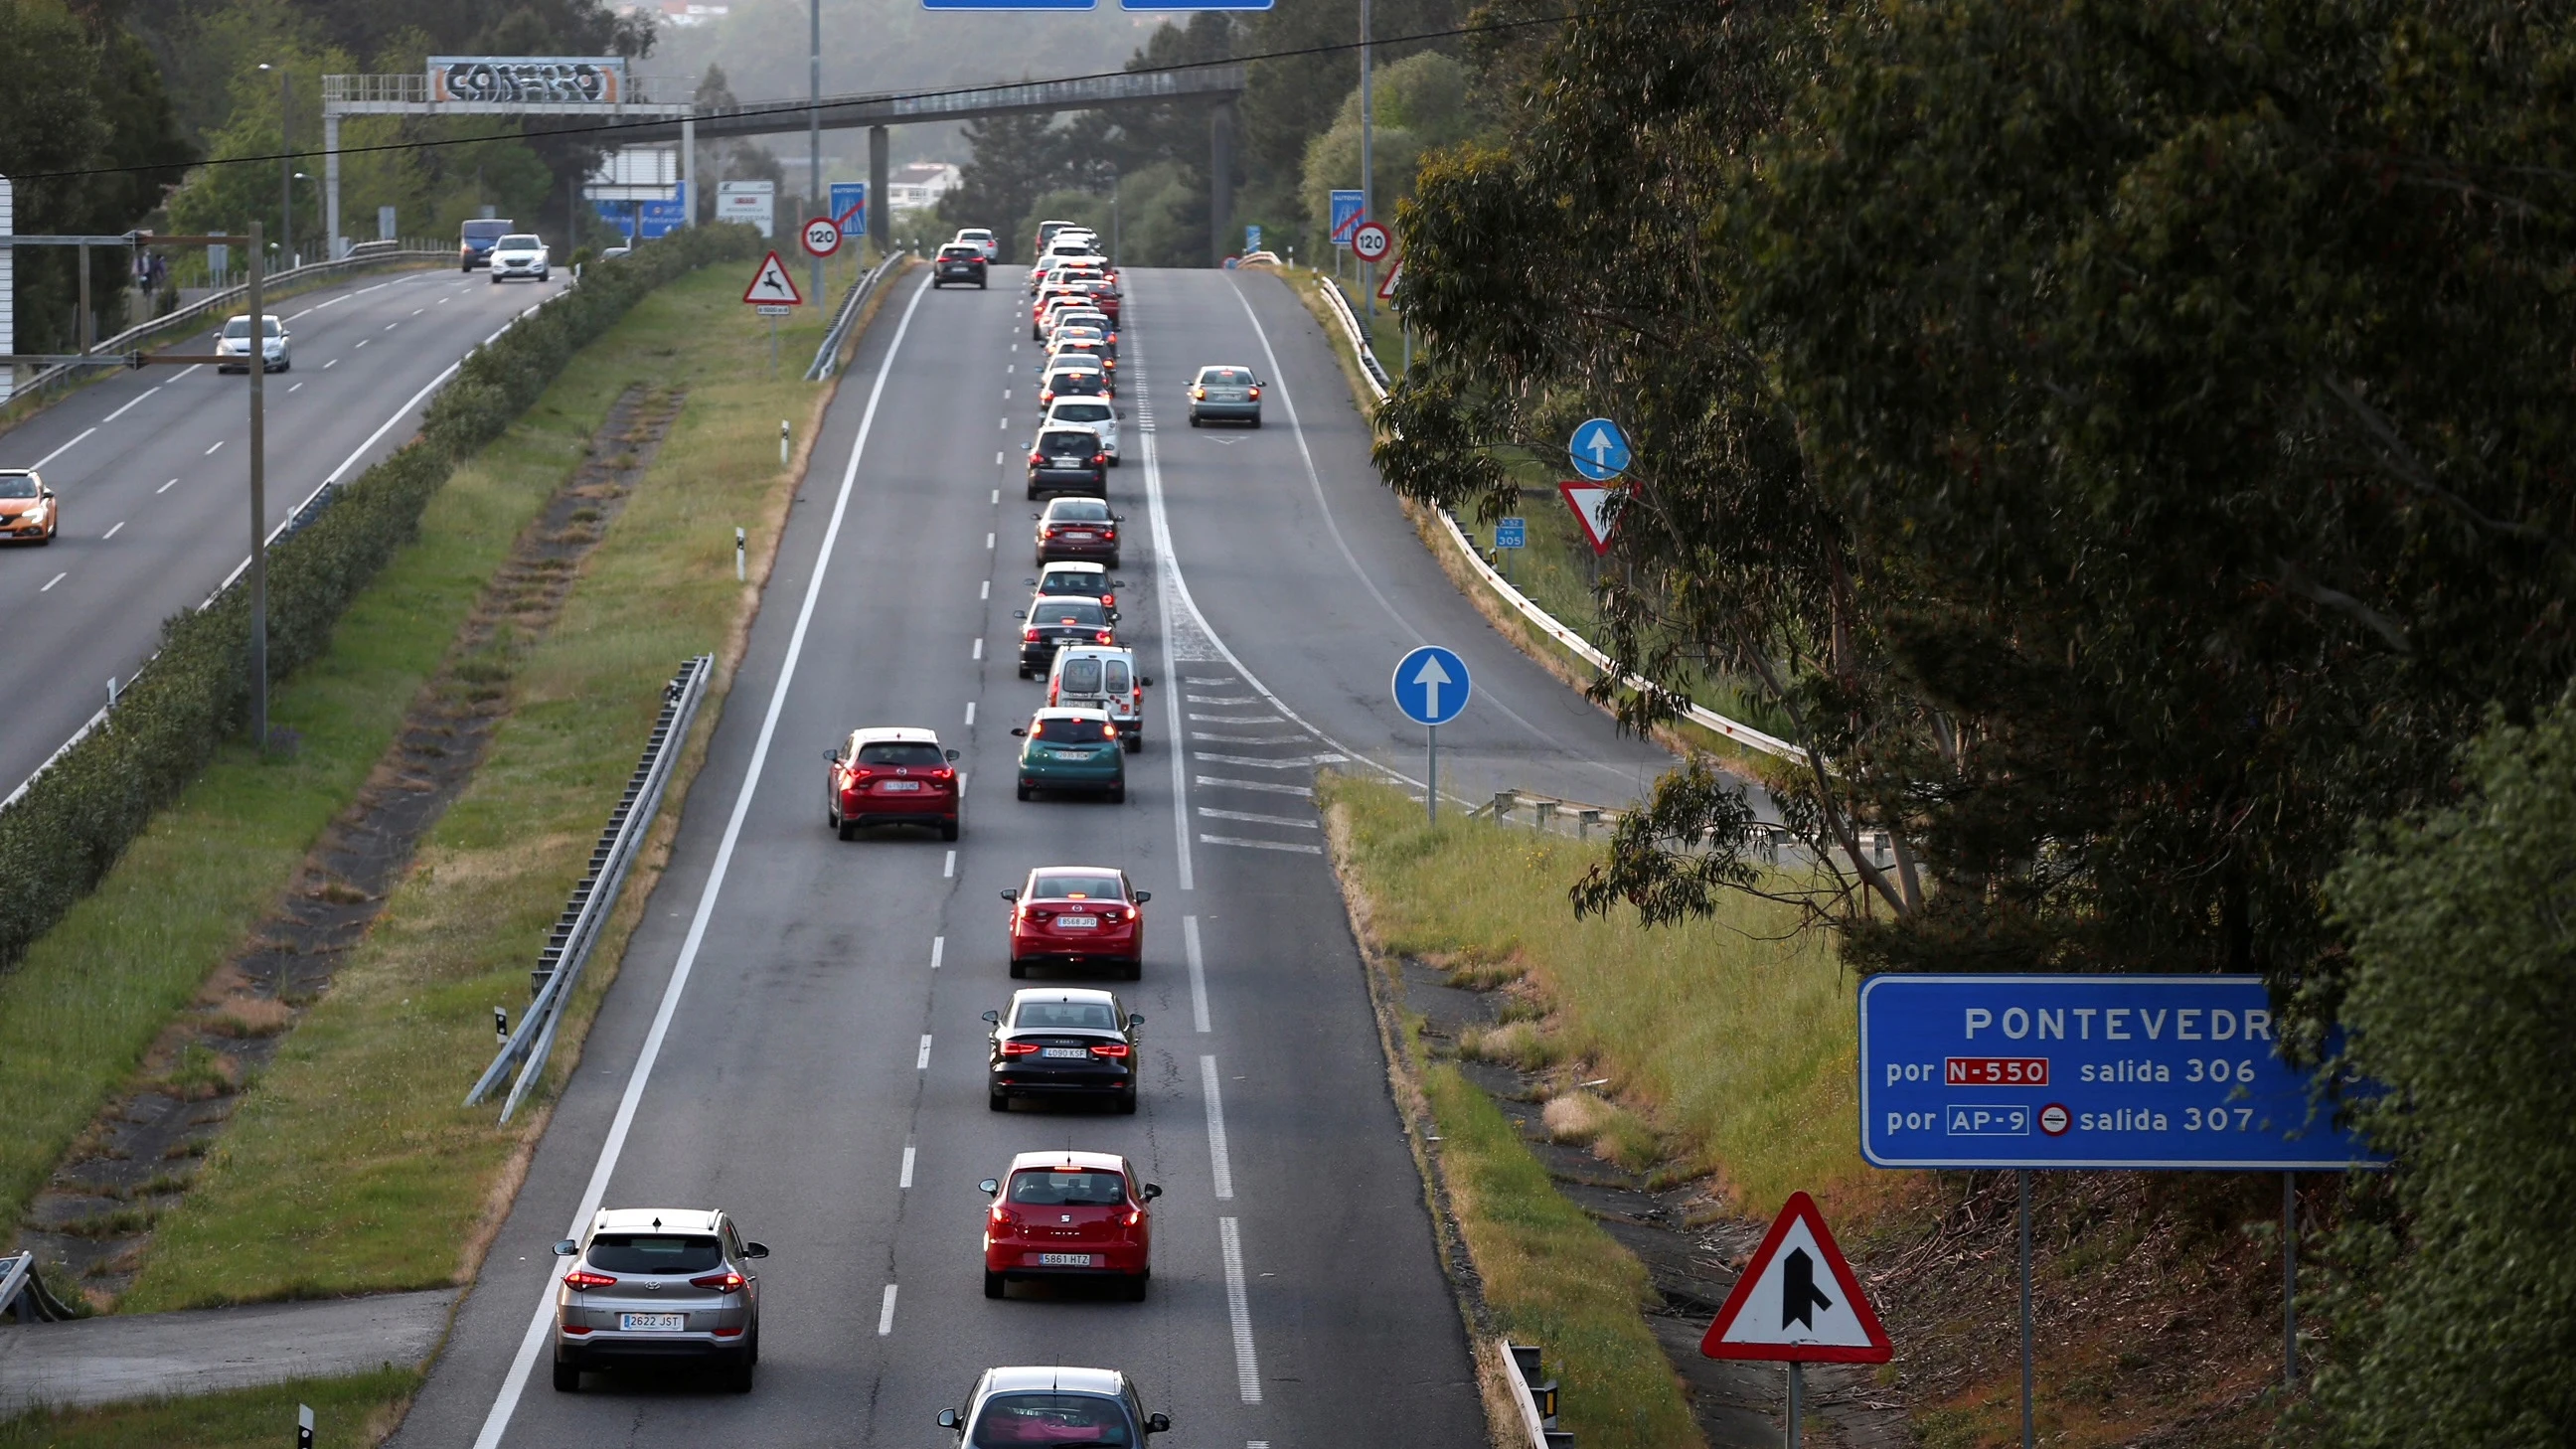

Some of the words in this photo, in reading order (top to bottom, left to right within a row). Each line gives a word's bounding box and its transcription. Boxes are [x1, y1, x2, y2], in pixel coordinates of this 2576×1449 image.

[809, 230, 835, 243] 120
[1360, 235, 1383, 249] 120
[1499, 537, 1522, 546] 305
[1965, 1007, 2273, 1041] PONTEVEDR
[1886, 1063, 1935, 1087] por
[1950, 1061, 2043, 1081] N-550
[2080, 1058, 2170, 1082] salida
[2185, 1058, 2255, 1082] 306
[1887, 1112, 1937, 1136] por
[1951, 1111, 2024, 1131] AP-9
[2079, 1108, 2168, 1131] salida
[2183, 1107, 2254, 1131] 307
[1045, 1254, 1067, 1264] 5861
[630, 1316, 657, 1327] 2622
[659, 1316, 679, 1327] JST
